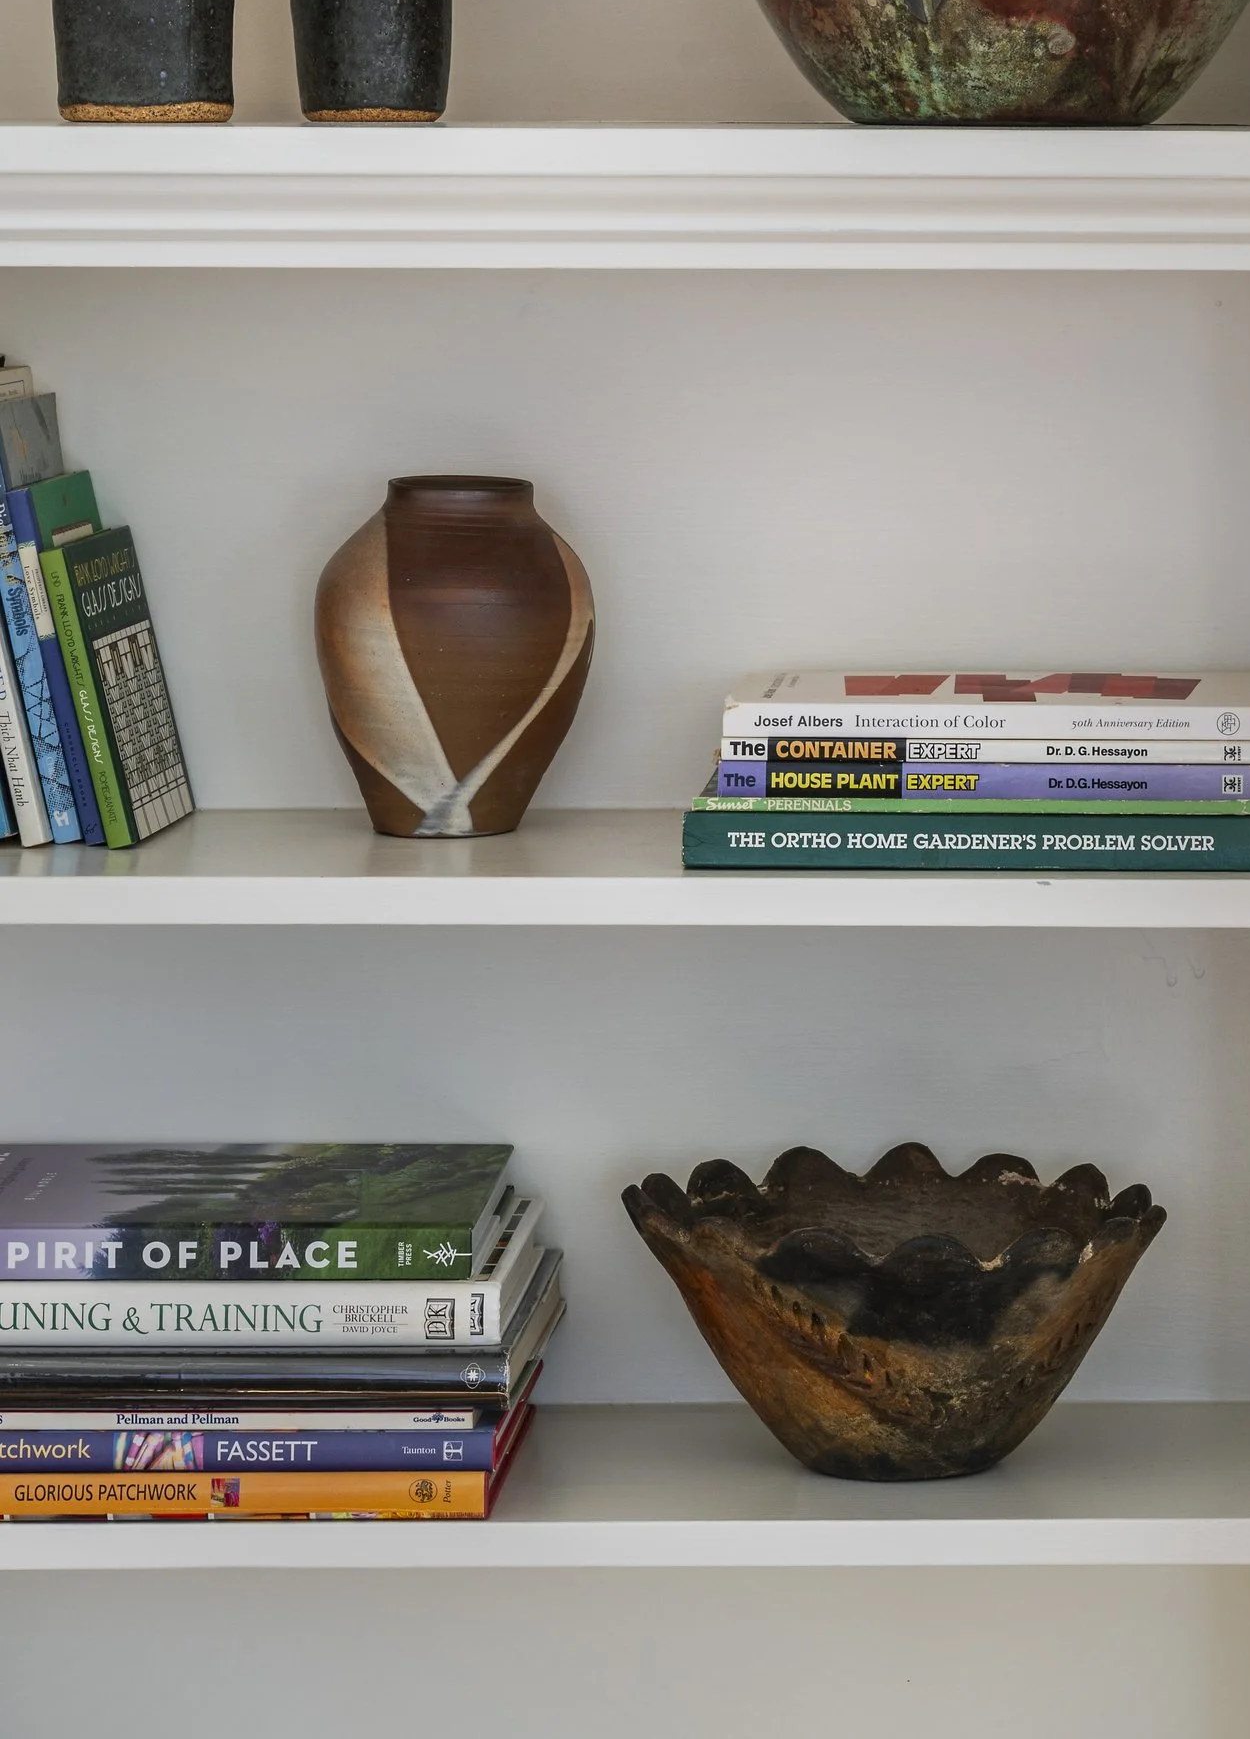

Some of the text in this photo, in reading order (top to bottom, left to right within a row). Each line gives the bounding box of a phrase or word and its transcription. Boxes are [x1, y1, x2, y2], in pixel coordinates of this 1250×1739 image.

[50, 571, 61, 588] LIND
[24, 565, 40, 620] Love Symbols
[81, 585, 107, 618] GLASS
[107, 573, 142, 608] DESIGNS
[6, 587, 28, 637] Symbols
[56, 594, 69, 620] FRANK
[62, 621, 75, 647] LLOYD
[78, 690, 94, 723] GLASS
[754, 715, 1007, 729] Josef Albers Interaction of Color
[1071, 718, 1191, 731] 50th Anniversary Edition
[64, 722, 80, 773] CHRONICLE
[86, 724, 104, 765] DESIGNS
[729, 740, 766, 756] The
[775, 740, 897, 759] CONTAINER
[908, 742, 981, 760] EXPERT
[1046, 746, 1061, 757] Dr.
[4, 746, 19, 772] Nhat
[11, 777, 30, 807] Hanh
[723, 773, 756, 787] The
[770, 772, 834, 789] HOUSE
[837, 773, 899, 790] PLANT
[906, 774, 980, 791] EXPERT
[1049, 778, 1064, 789] Dr.
[98, 771, 118, 824] POMEGRANATE
[705, 798, 852, 811] Sunset PERENNIALS
[727, 832, 1215, 851] THE ORTHO HOME GARDENER'S PROBLEM SOLVER
[7, 1241, 358, 1269] PIRIT OF PLACE
[122, 1306, 149, 1335] &
[150, 1303, 322, 1333] TRAINING
[332, 1304, 409, 1315] CHRISTOPHER
[344, 1313, 396, 1323] BRICKELL
[371, 1326, 398, 1334] JOYCE
[116, 1413, 239, 1425] Pellman and Pellman
[413, 1415, 466, 1424] Good Books
[217, 1440, 318, 1461] FASSETT
[402, 1446, 436, 1455] Taunton
[14, 1483, 197, 1502] GLORIOUS PATCHWORK
[443, 1479, 452, 1503] Potter
